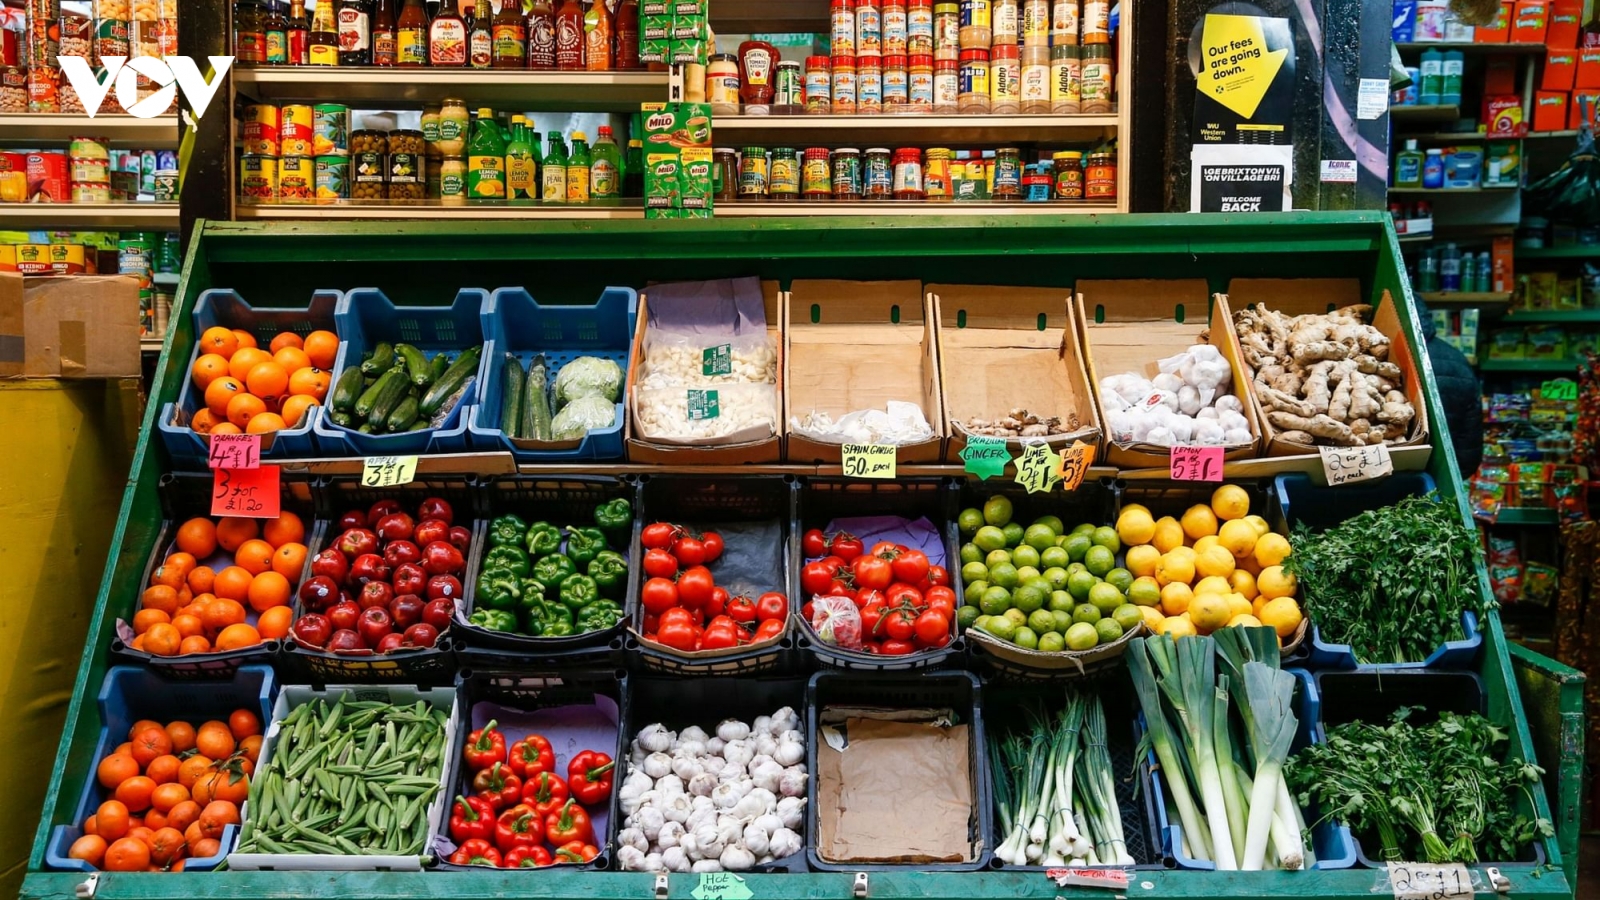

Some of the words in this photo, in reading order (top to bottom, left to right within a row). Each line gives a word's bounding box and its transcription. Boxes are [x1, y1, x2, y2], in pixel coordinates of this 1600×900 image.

[1209, 45, 1228, 57] Our
[1230, 38, 1253, 50] fees
[1211, 58, 1228, 68] are
[1230, 48, 1260, 65] going
[1060, 66, 1069, 94] Adobo
[1213, 66, 1245, 80] down.
[998, 67, 1007, 94] Adobo
[649, 117, 672, 128] MILO
[695, 129, 706, 138] MILO
[658, 166, 674, 174] MILO
[1221, 203, 1261, 212] BACK
[214, 434, 253, 442] ORANGES
[210, 443, 230, 467] 4
[870, 445, 894, 455] GARLIC
[963, 446, 1005, 460] GINGER
[1024, 447, 1047, 459] LIME
[1064, 448, 1084, 459] LIME
[1173, 447, 1201, 456] LEMON
[872, 463, 890, 472] EACH
[1172, 457, 1185, 478] 5
[1329, 453, 1350, 471] 2
[367, 465, 384, 485] 3
[1020, 458, 1033, 482] 5
[1062, 459, 1075, 483] 5
[1347, 470, 1364, 480] each
[216, 468, 230, 499] 3
[225, 497, 263, 511] £1.20
[706, 873, 729, 884] Hot
[1394, 867, 1420, 891] 2
